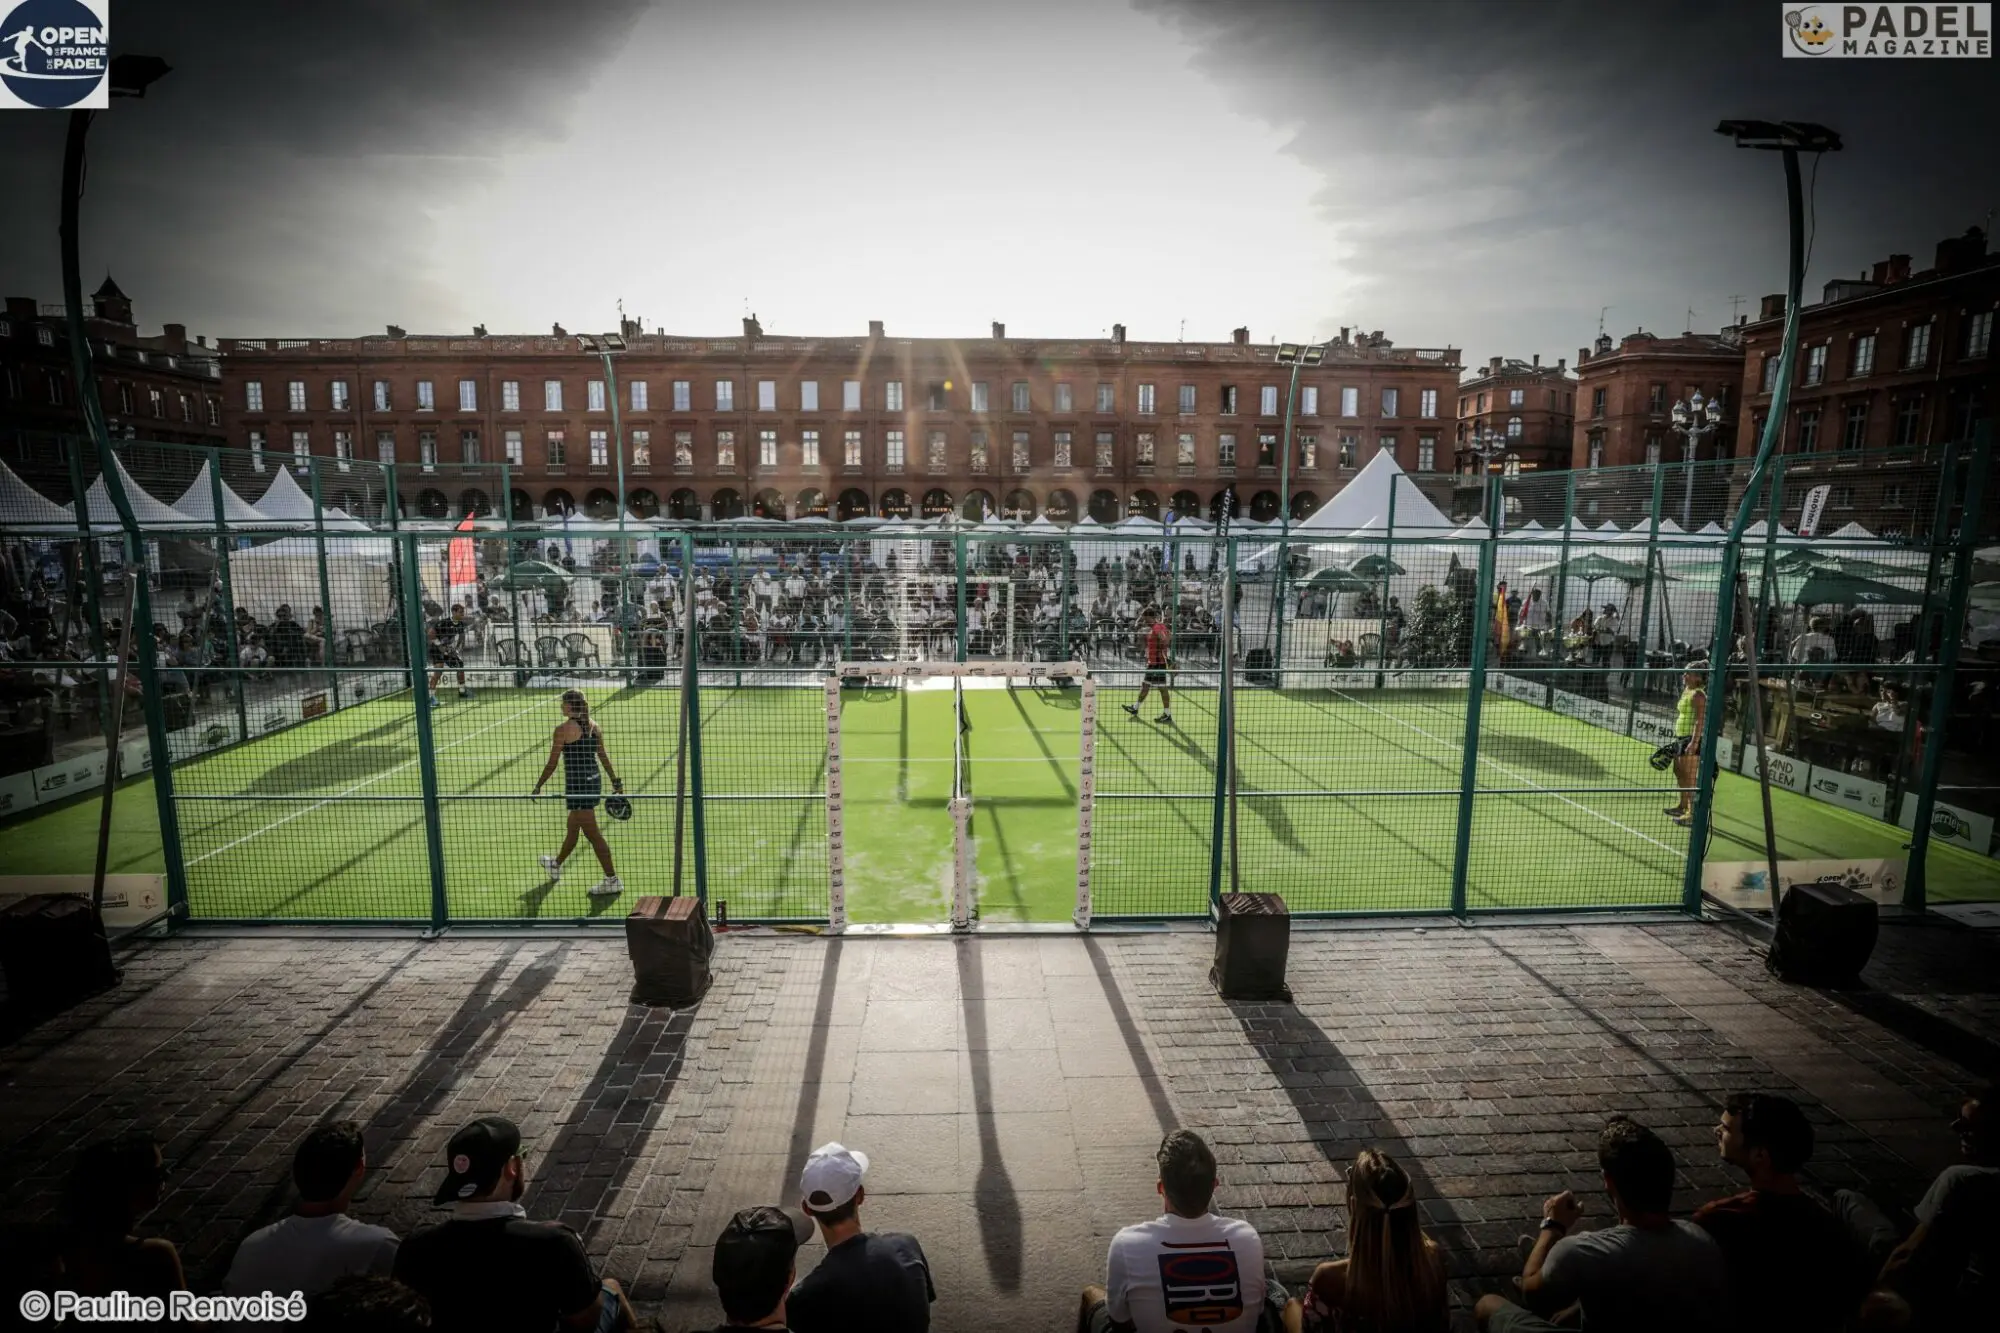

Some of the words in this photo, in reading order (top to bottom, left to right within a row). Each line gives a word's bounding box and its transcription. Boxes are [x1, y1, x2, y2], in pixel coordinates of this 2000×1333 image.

[1636, 719, 1656, 733] COPY
[1754, 765, 1795, 788] CELEM
[1823, 875, 1842, 884] OPEN
